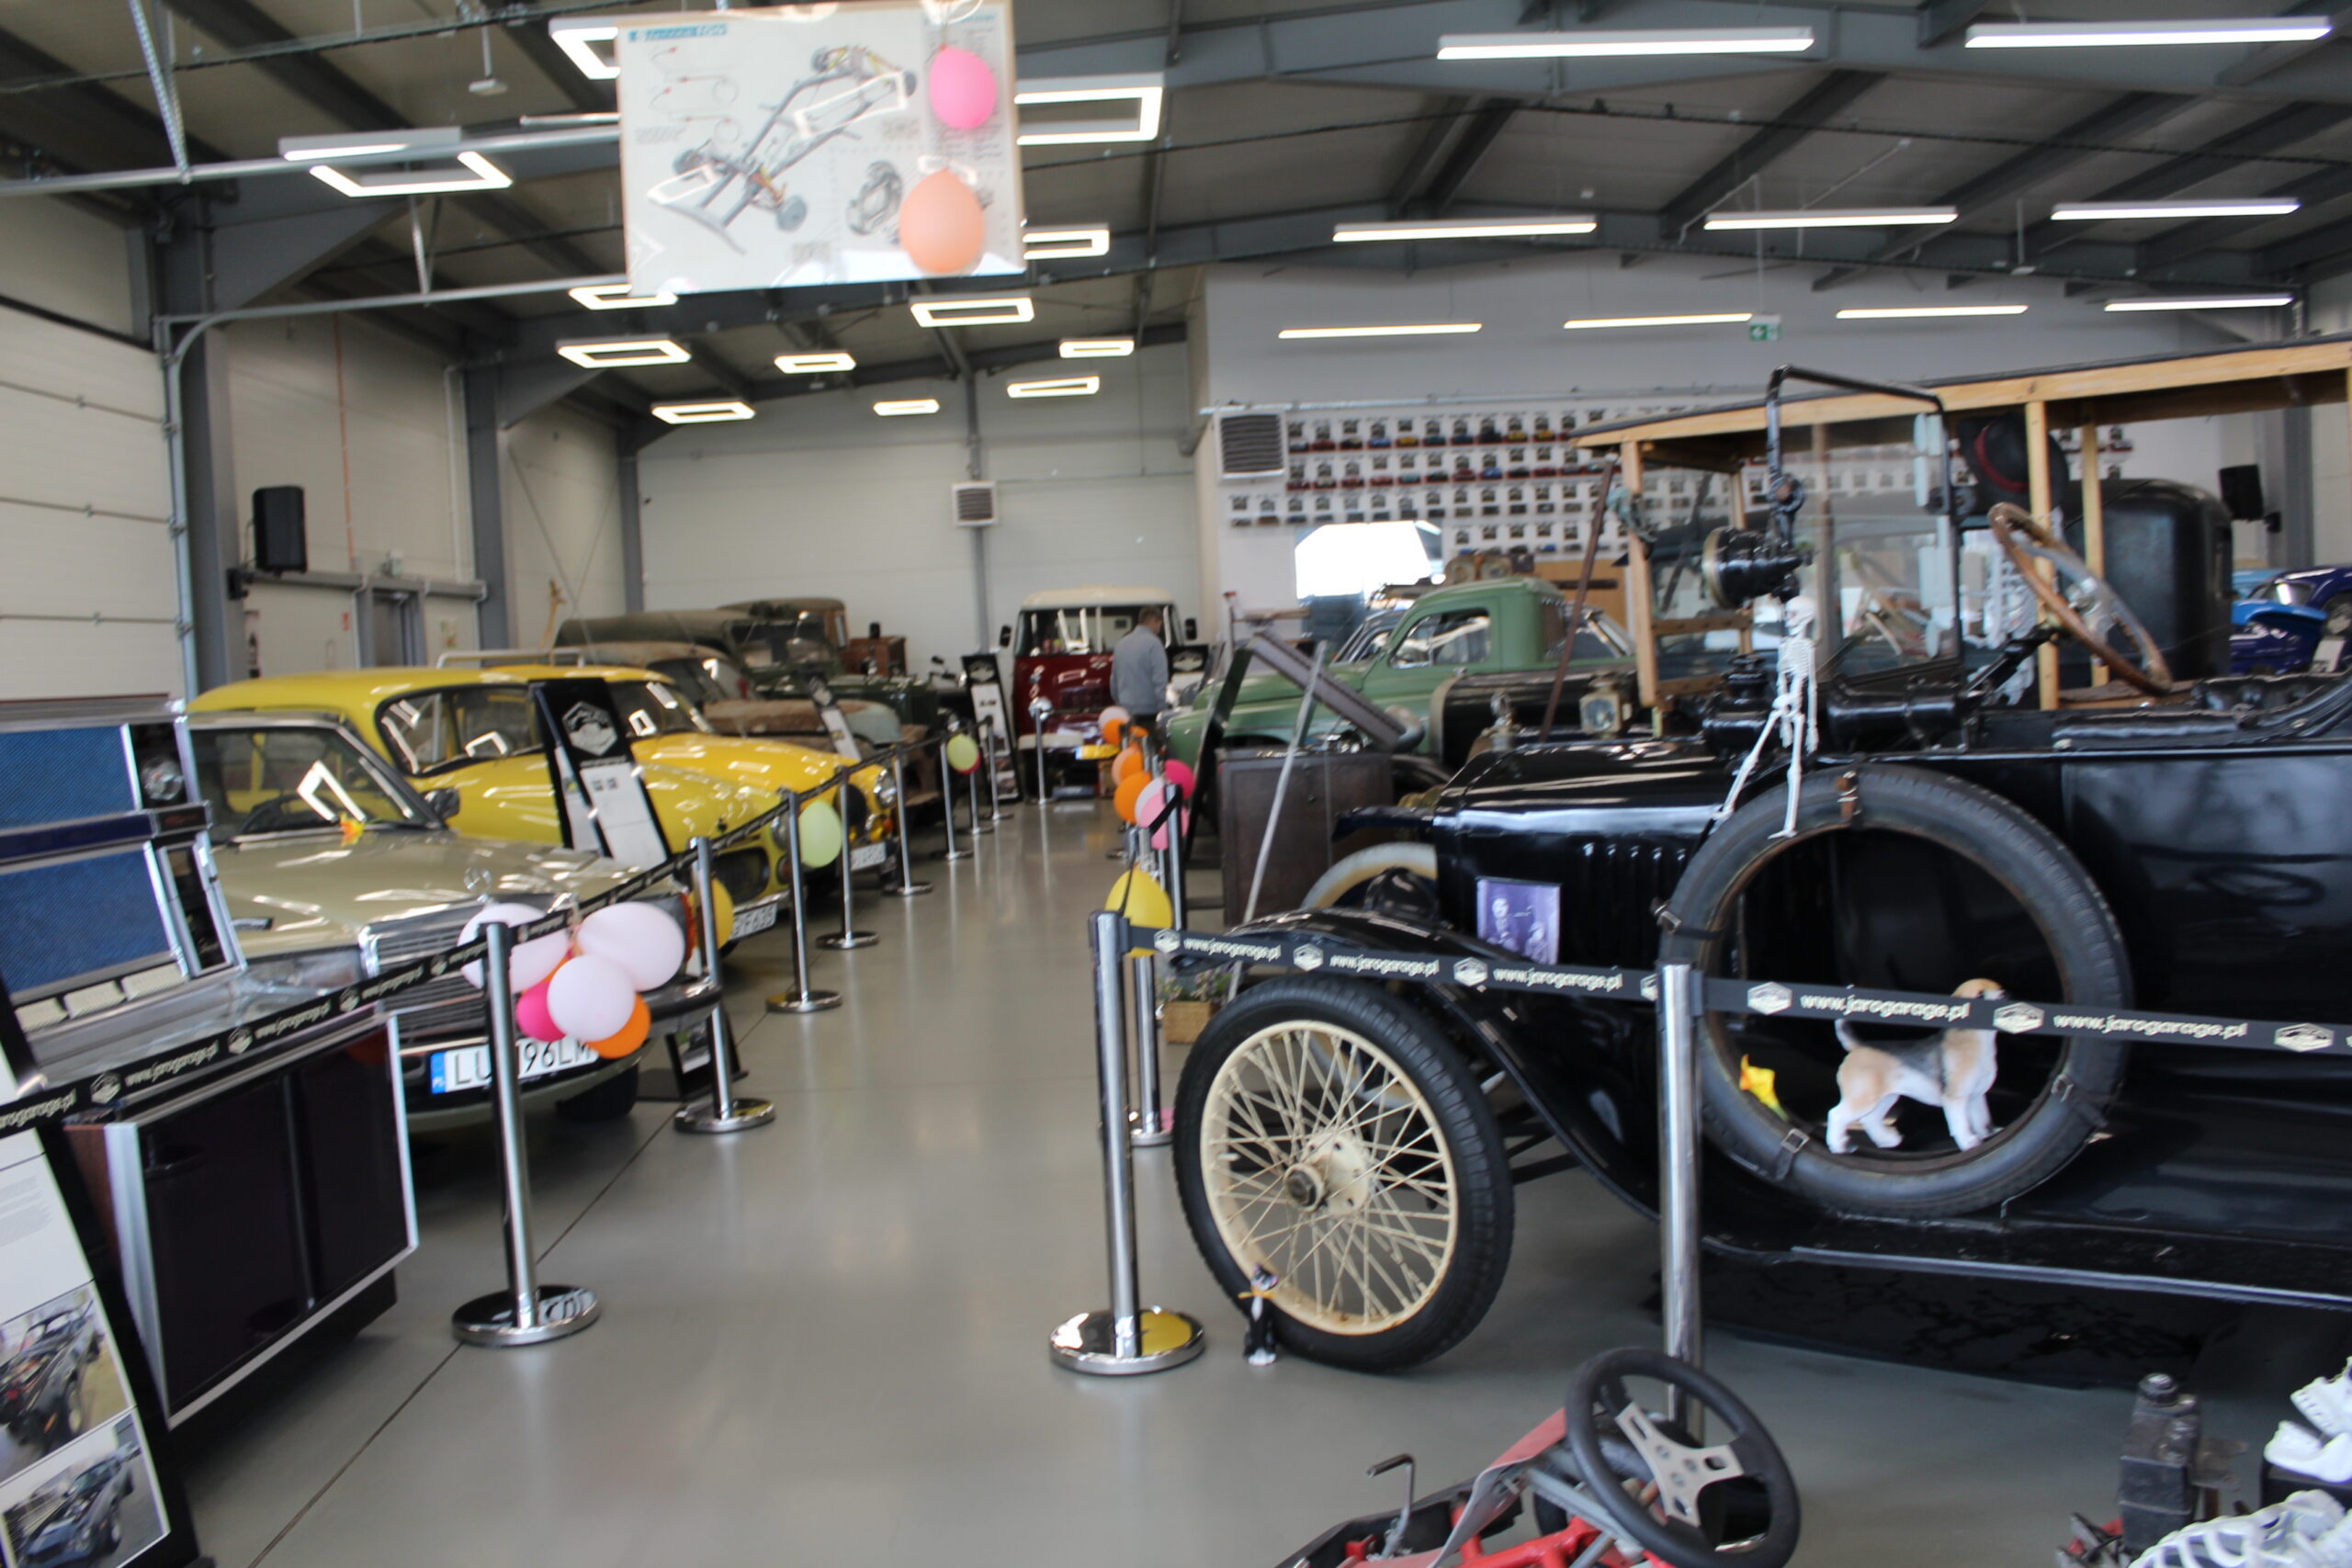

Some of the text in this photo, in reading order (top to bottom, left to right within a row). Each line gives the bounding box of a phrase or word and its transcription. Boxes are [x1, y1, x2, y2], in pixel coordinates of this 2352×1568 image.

[1329, 953, 1440, 978] www.jarogarage.pl
[1493, 967, 1623, 993] www.jarogarage.pl
[1800, 994, 1972, 1022] www.jarogarage.pl
[2052, 1014, 2249, 1040] www.jarogarage.pl
[520, 1038, 593, 1074] 96LM
